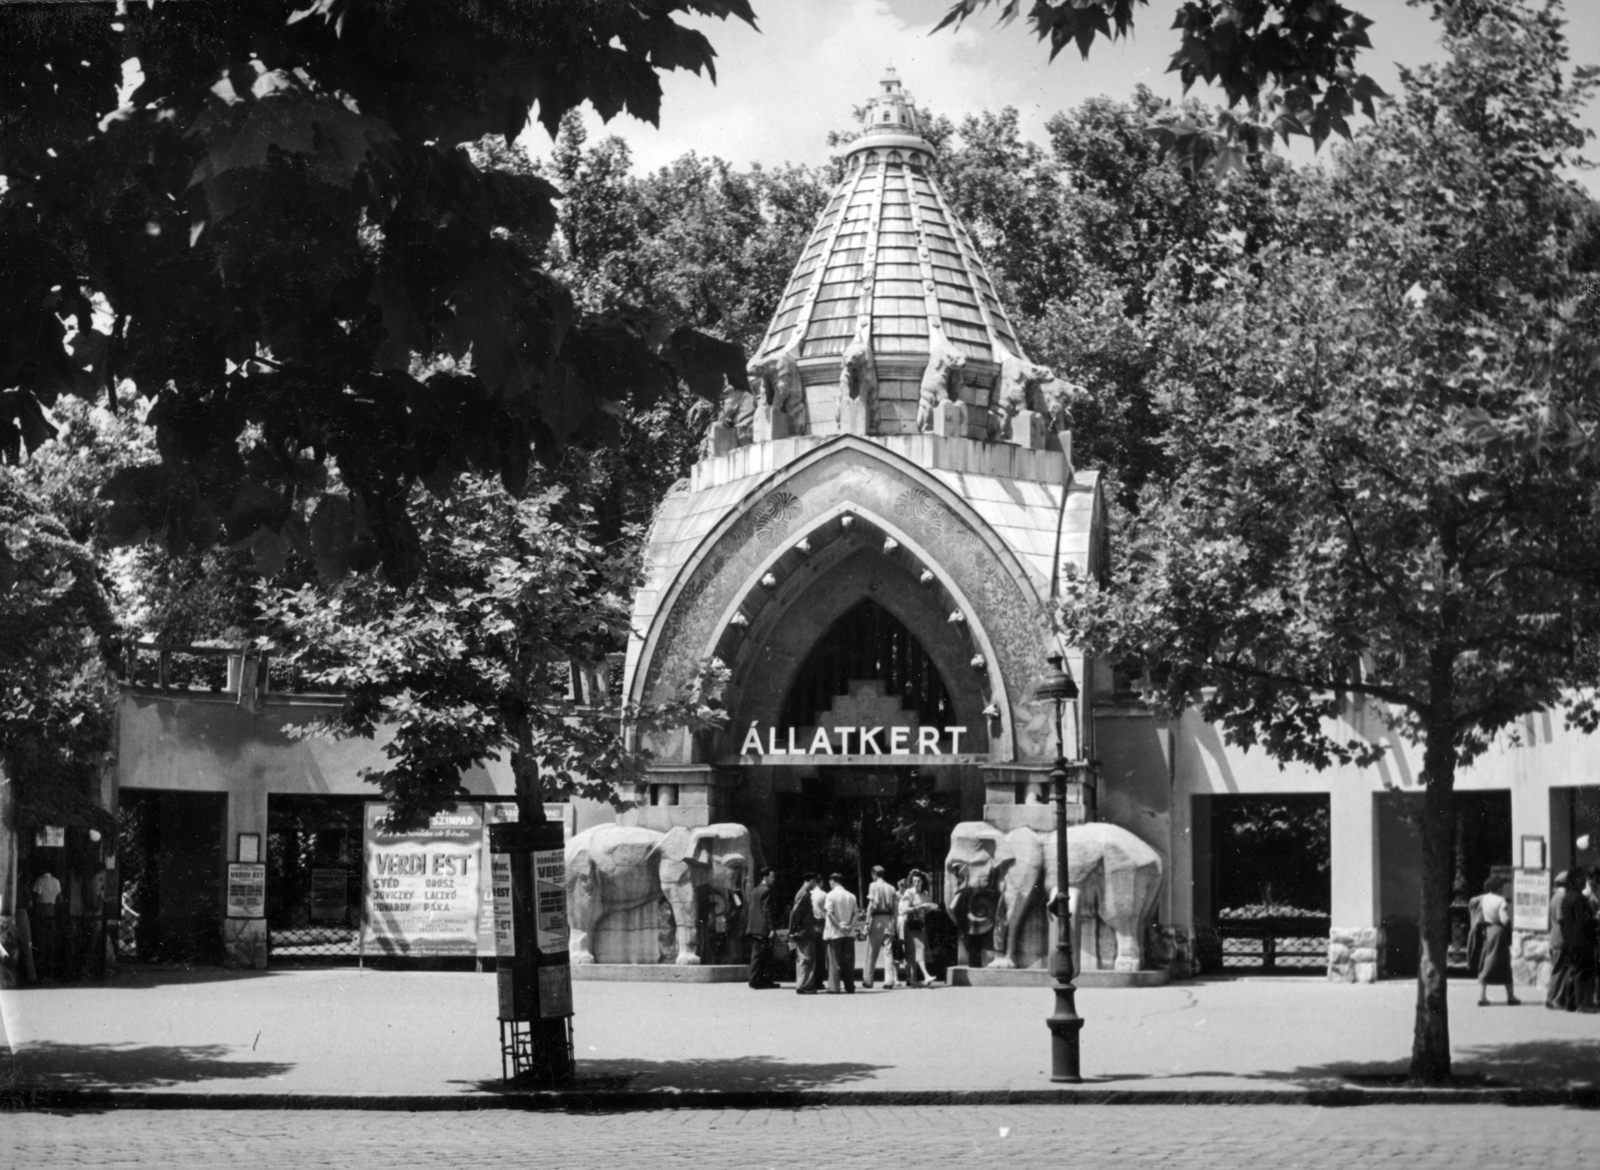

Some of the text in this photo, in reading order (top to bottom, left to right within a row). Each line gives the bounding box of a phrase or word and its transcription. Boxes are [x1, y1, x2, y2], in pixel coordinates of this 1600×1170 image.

[740, 720, 967, 755] ÁLLATKERT
[375, 853, 472, 876] VERDI EST
[373, 876, 400, 888] SVÉD
[423, 901, 450, 912] PÁKA
